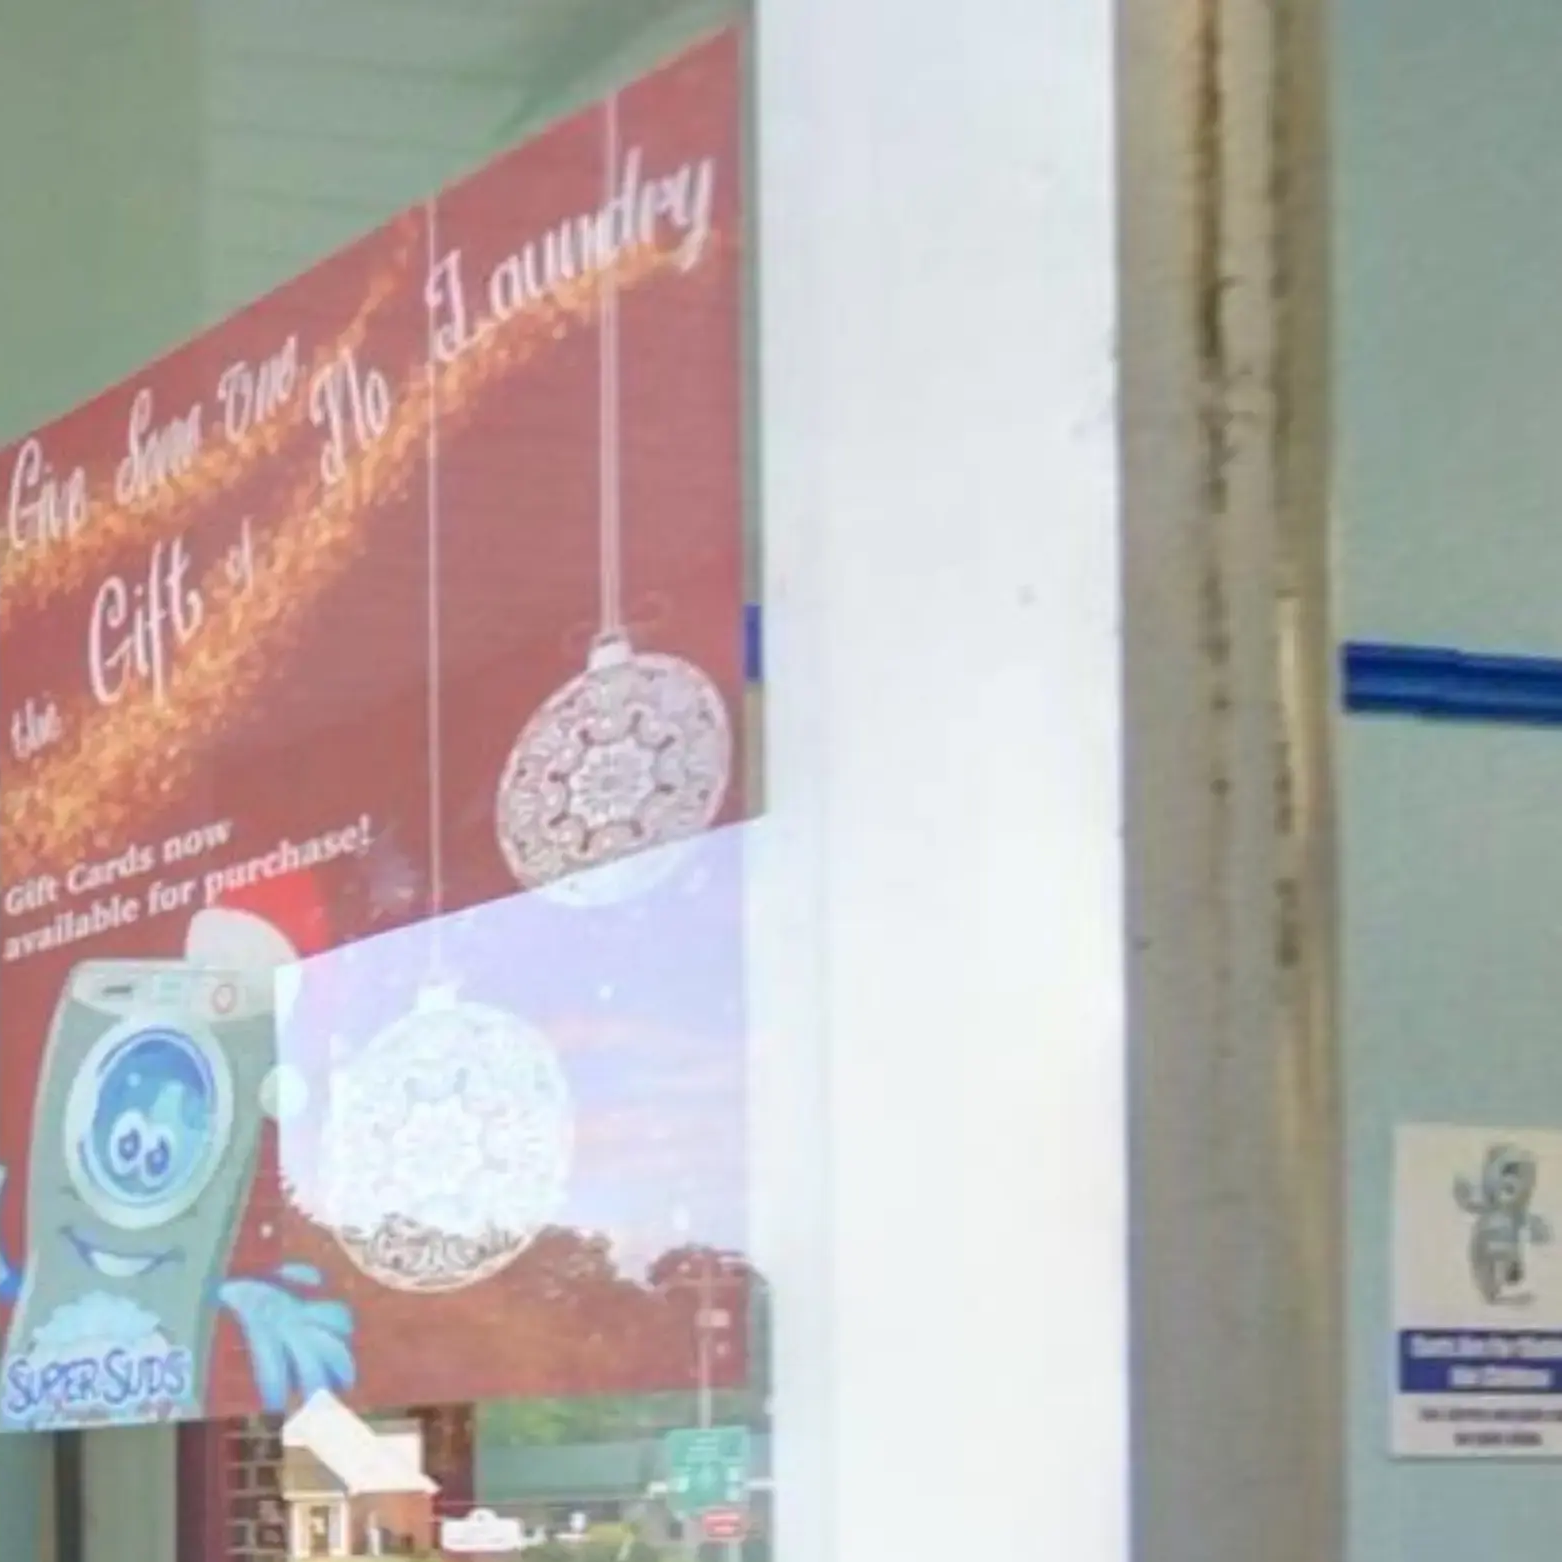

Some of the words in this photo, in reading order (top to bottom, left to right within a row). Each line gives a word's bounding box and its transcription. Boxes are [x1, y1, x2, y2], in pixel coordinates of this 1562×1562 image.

[88, 536, 204, 714] Gift
[309, 346, 391, 486] No
[423, 147, 713, 364] Laundry
[2, 892, 140, 962] available
[147, 875, 196, 914] for
[203, 813, 373, 904] purchase!
[4, 874, 60, 917] Gift
[65, 841, 155, 893] Cards
[162, 818, 234, 864] now
